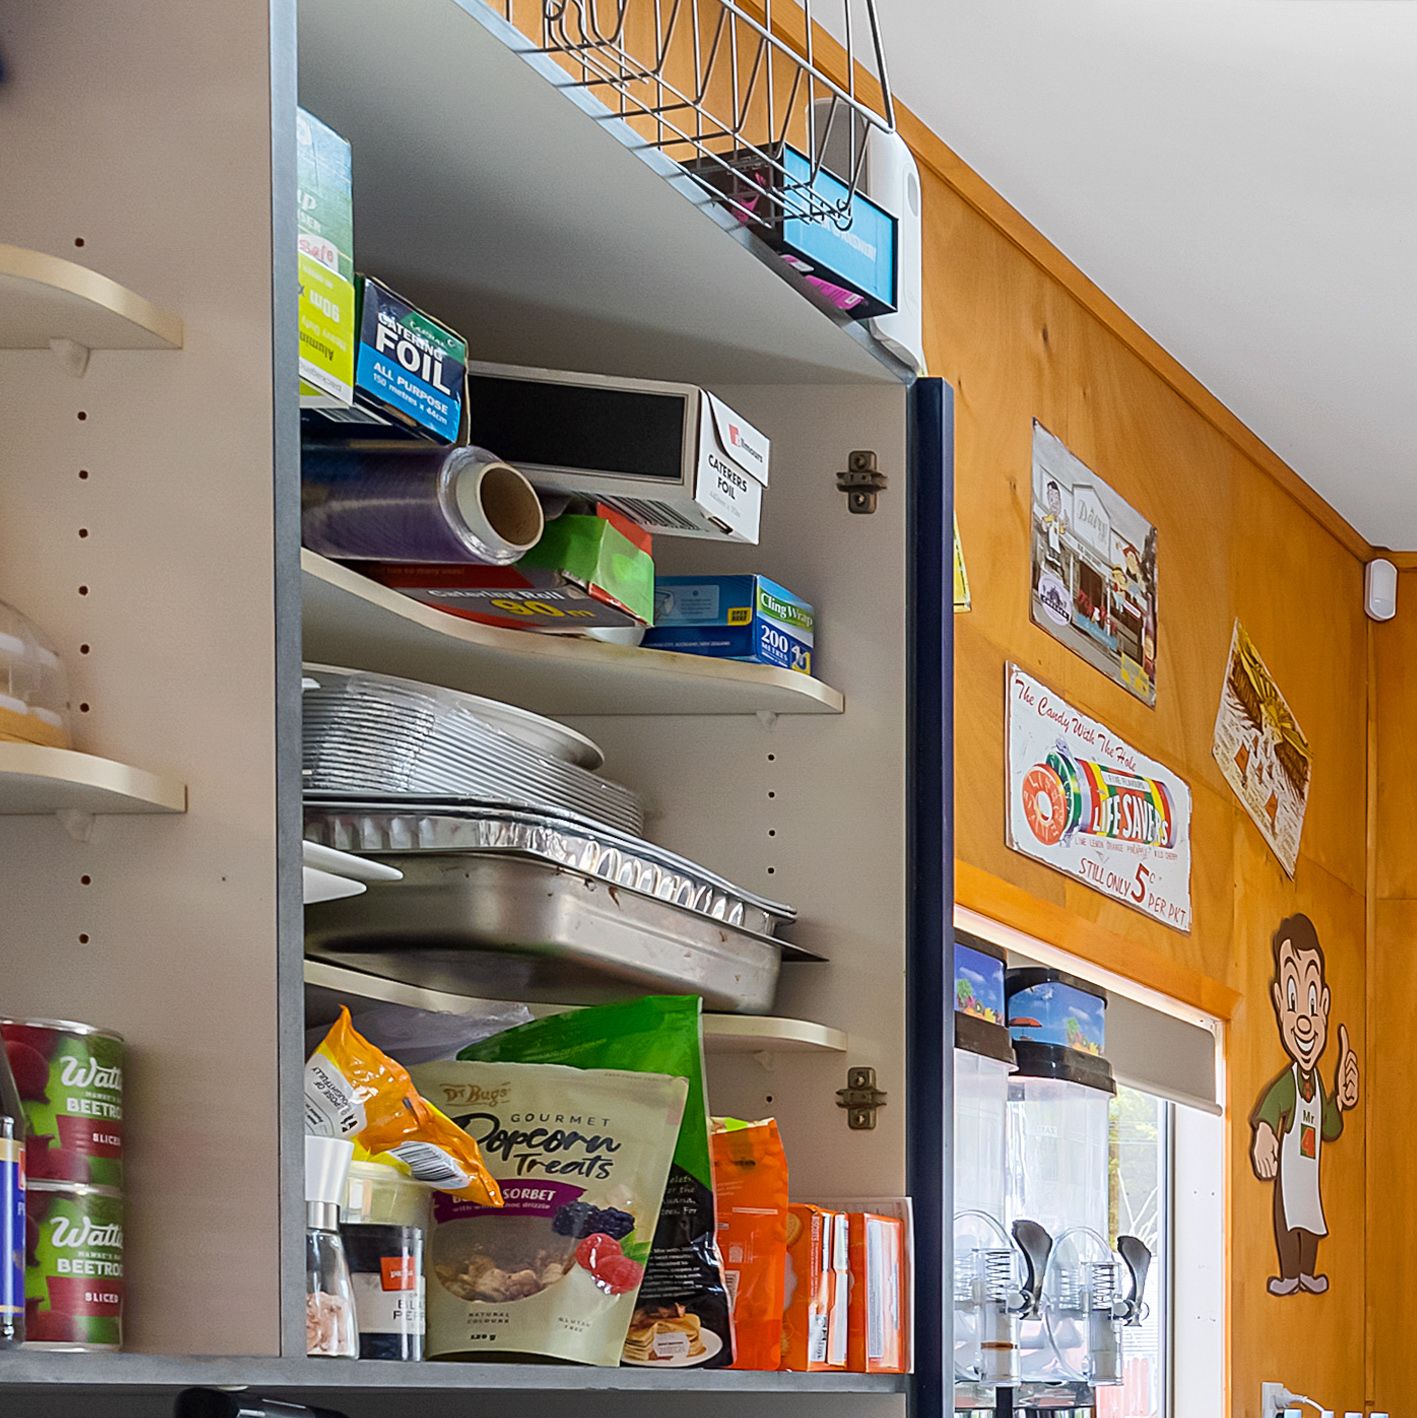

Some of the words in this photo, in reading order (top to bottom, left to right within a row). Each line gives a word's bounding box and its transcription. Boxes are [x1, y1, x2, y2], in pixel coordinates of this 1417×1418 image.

[310, 290, 340, 323] 90m
[378, 312, 447, 361] CATERING
[376, 323, 451, 395] FOIL
[373, 362, 394, 381] ALL
[397, 377, 449, 415] PURPOSE
[373, 373, 387, 387] 150
[389, 384, 417, 407] metres
[708, 454, 748, 492] CATERERS
[717, 477, 736, 500] FOIL
[428, 589, 520, 601] Catering
[519, 590, 566, 600] Roll
[760, 593, 787, 618] Cling
[761, 625, 789, 653] 200
[761, 642, 789, 661] METRES
[1015, 679, 1034, 706] The
[1038, 697, 1070, 733] Candy
[1072, 718, 1095, 745] With
[1098, 734, 1113, 758] The
[1116, 747, 1136, 772] Hole
[1093, 794, 1121, 833] LIFE
[1122, 794, 1169, 846] SAVERS
[1078, 857, 1104, 886] STILL
[1107, 872, 1131, 897] ONLY
[1148, 892, 1166, 917] PER
[511, 1113, 612, 1127] GOURMET
[1303, 1110, 1315, 1124] Mr
[451, 1112, 622, 1161] Popcorn
[1302, 1127, 1315, 1158] 4
[513, 1152, 615, 1180] Treats
[502, 1188, 557, 1201] SORBET
